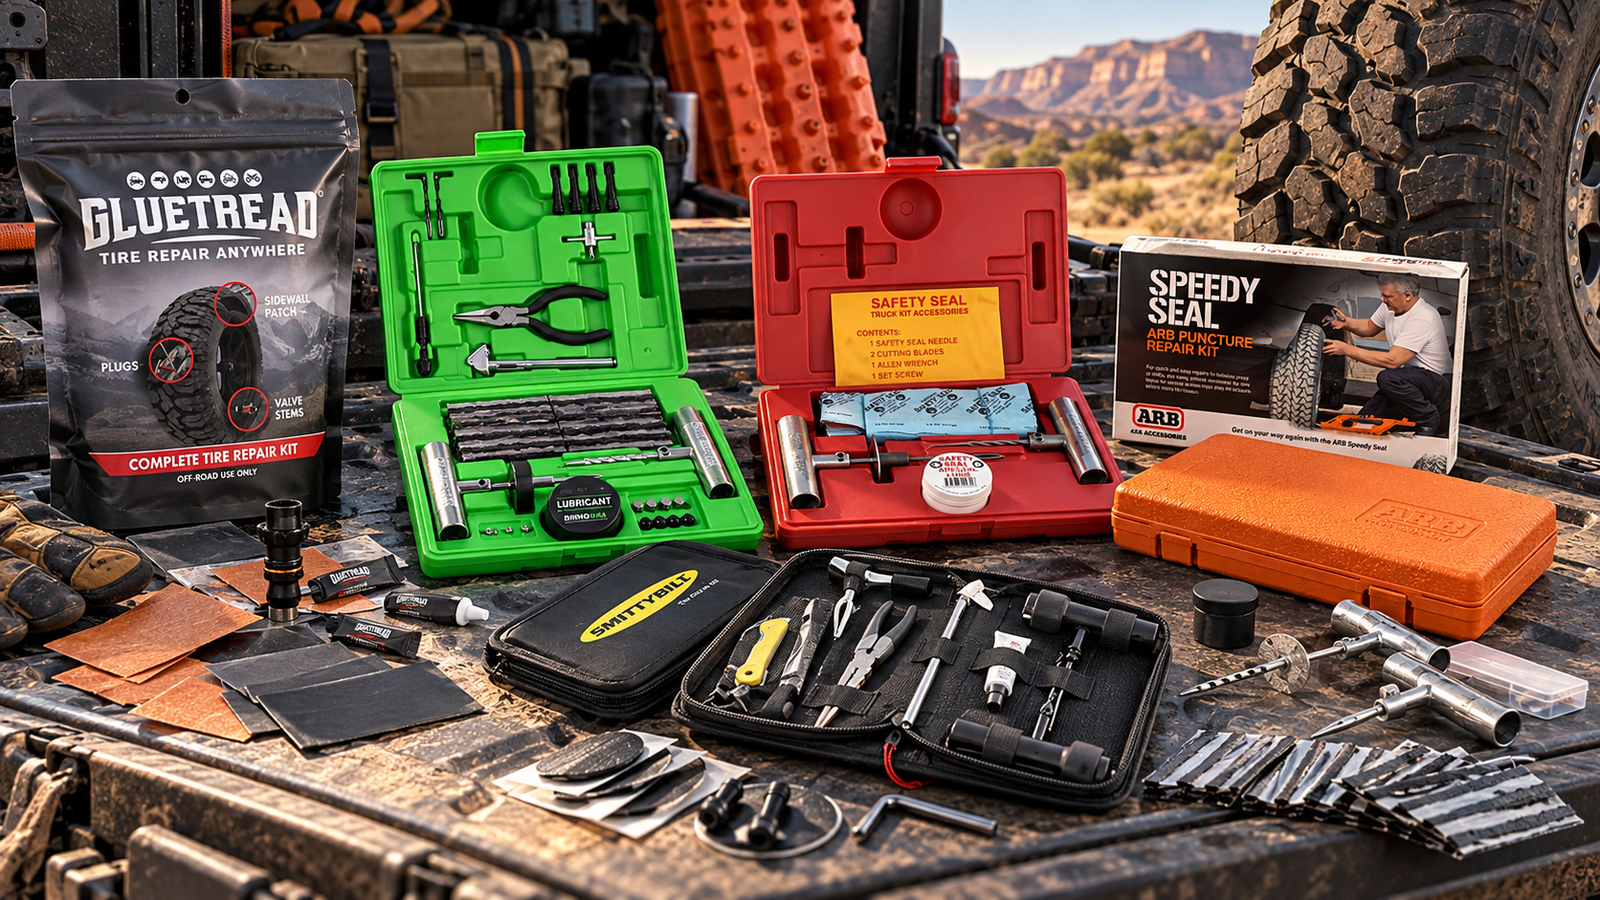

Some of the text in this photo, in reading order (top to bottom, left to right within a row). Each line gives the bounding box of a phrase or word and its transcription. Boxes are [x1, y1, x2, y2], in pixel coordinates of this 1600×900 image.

[79, 191, 317, 251] GLUETREAD
[99, 243, 305, 265] TIRE REPAIR ANYWHERE
[1149, 269, 1260, 304] SPEEDY
[264, 294, 311, 306] SIDEWALL
[871, 295, 967, 309] SAFETY SEAL
[264, 307, 298, 318] PATCH
[871, 310, 897, 318] TRUCK
[913, 308, 969, 317] ACCESSORIES
[1148, 297, 1219, 329] SEAL
[856, 329, 901, 337] CONTENTS:
[1147, 328, 1253, 349] ARB PUNCTURE
[876, 339, 904, 347] SAFETY
[928, 337, 958, 345] NEEDLE
[1147, 340, 1219, 357] REPAIR KIT
[877, 350, 911, 358] CUTTING
[913, 348, 944, 356] BLADES
[101, 361, 139, 372] PLUGS
[903, 359, 938, 367] WRENCH
[275, 396, 303, 408] VALVE
[275, 408, 304, 420] STEMS
[1137, 408, 1180, 427] ARB
[1144, 430, 1187, 441] ACCESSORIES
[1232, 426, 1243, 434] Get
[1254, 430, 1269, 438] your
[1270, 432, 1284, 440] way
[1285, 434, 1303, 442] again
[1304, 435, 1319, 443] with
[1348, 441, 1372, 451] Speedy
[1373, 443, 1387, 451] Seal
[128, 442, 298, 471] COMPLETE TIRE REPAIR KIT
[177, 468, 258, 483] OFF-ROAD USE ONLY
[557, 497, 612, 509] LUBRICANT
[1372, 505, 1465, 534] ARB
